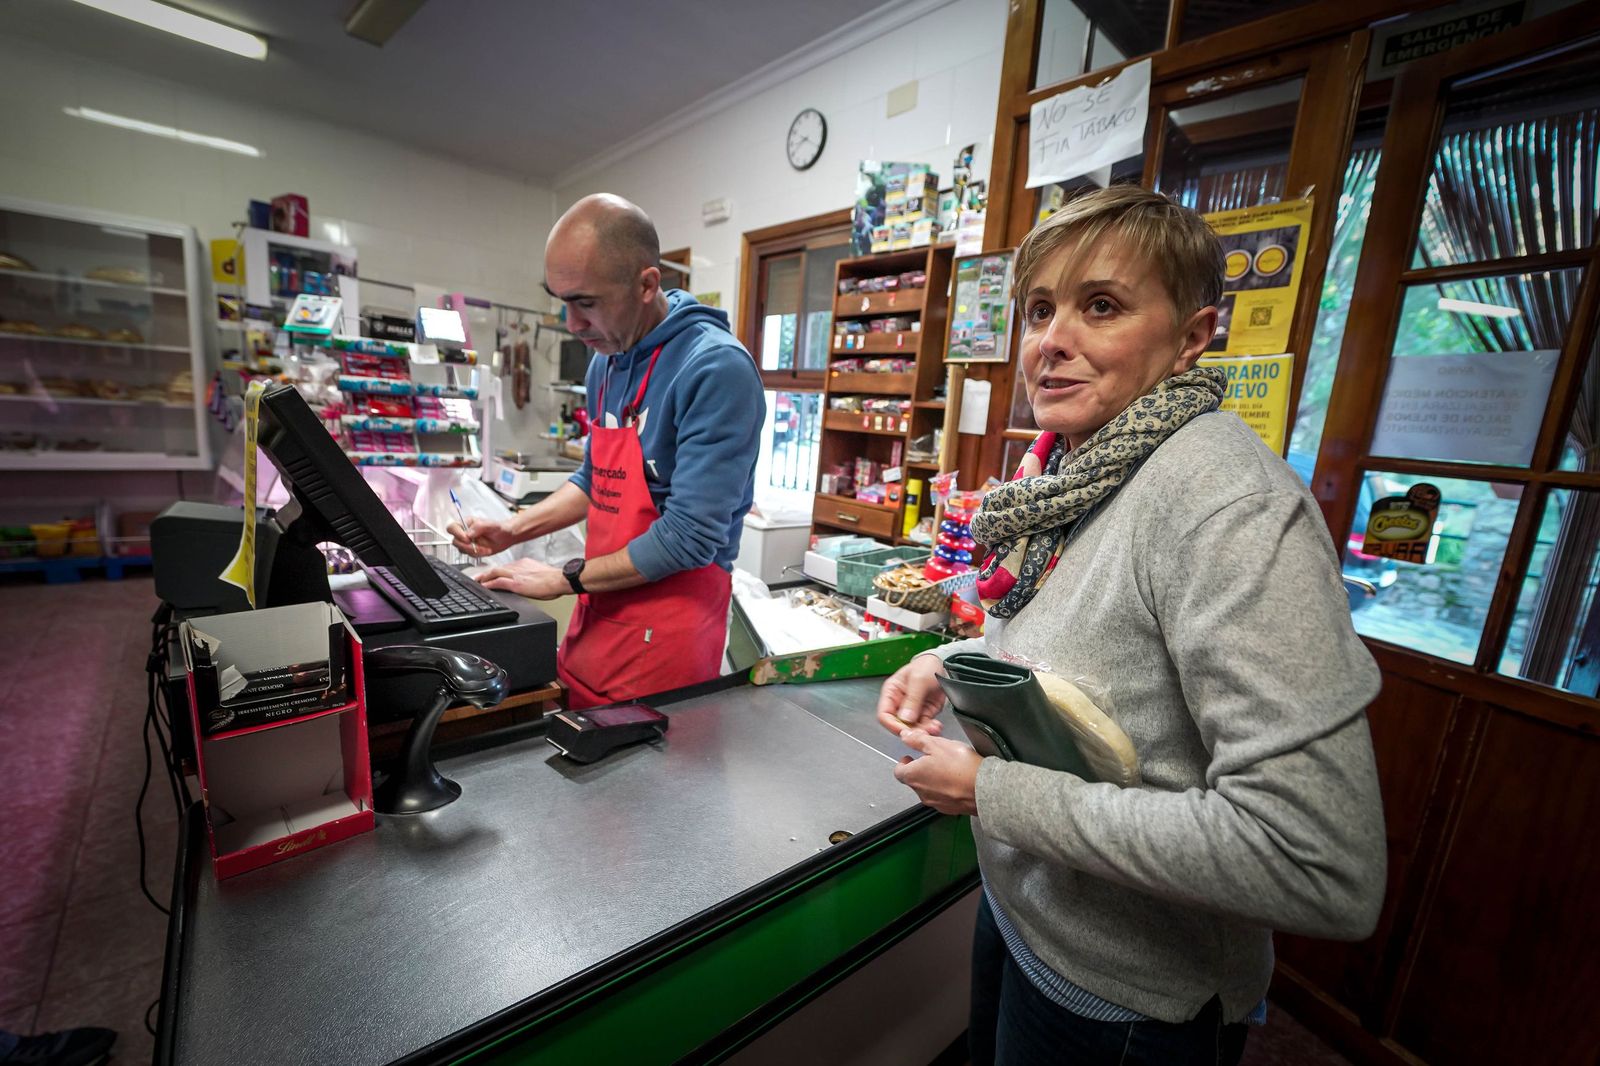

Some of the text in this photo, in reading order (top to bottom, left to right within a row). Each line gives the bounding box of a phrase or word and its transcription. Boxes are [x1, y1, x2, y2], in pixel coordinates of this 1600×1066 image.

[1401, 9, 1504, 47] SALIDA DE
[1037, 85, 1113, 130] NO SE
[1035, 106, 1137, 164] FIA TABACO
[1217, 362, 1280, 380] RARIO
[1224, 382, 1268, 399] UEVO
[1237, 410, 1271, 419] TIEMBRE
[1373, 515, 1421, 532] Cheetos
[238, 701, 290, 715] IRRESISTIBLEMENTE
[290, 697, 318, 707] CREMOSO
[265, 708, 293, 718] NEGRO
